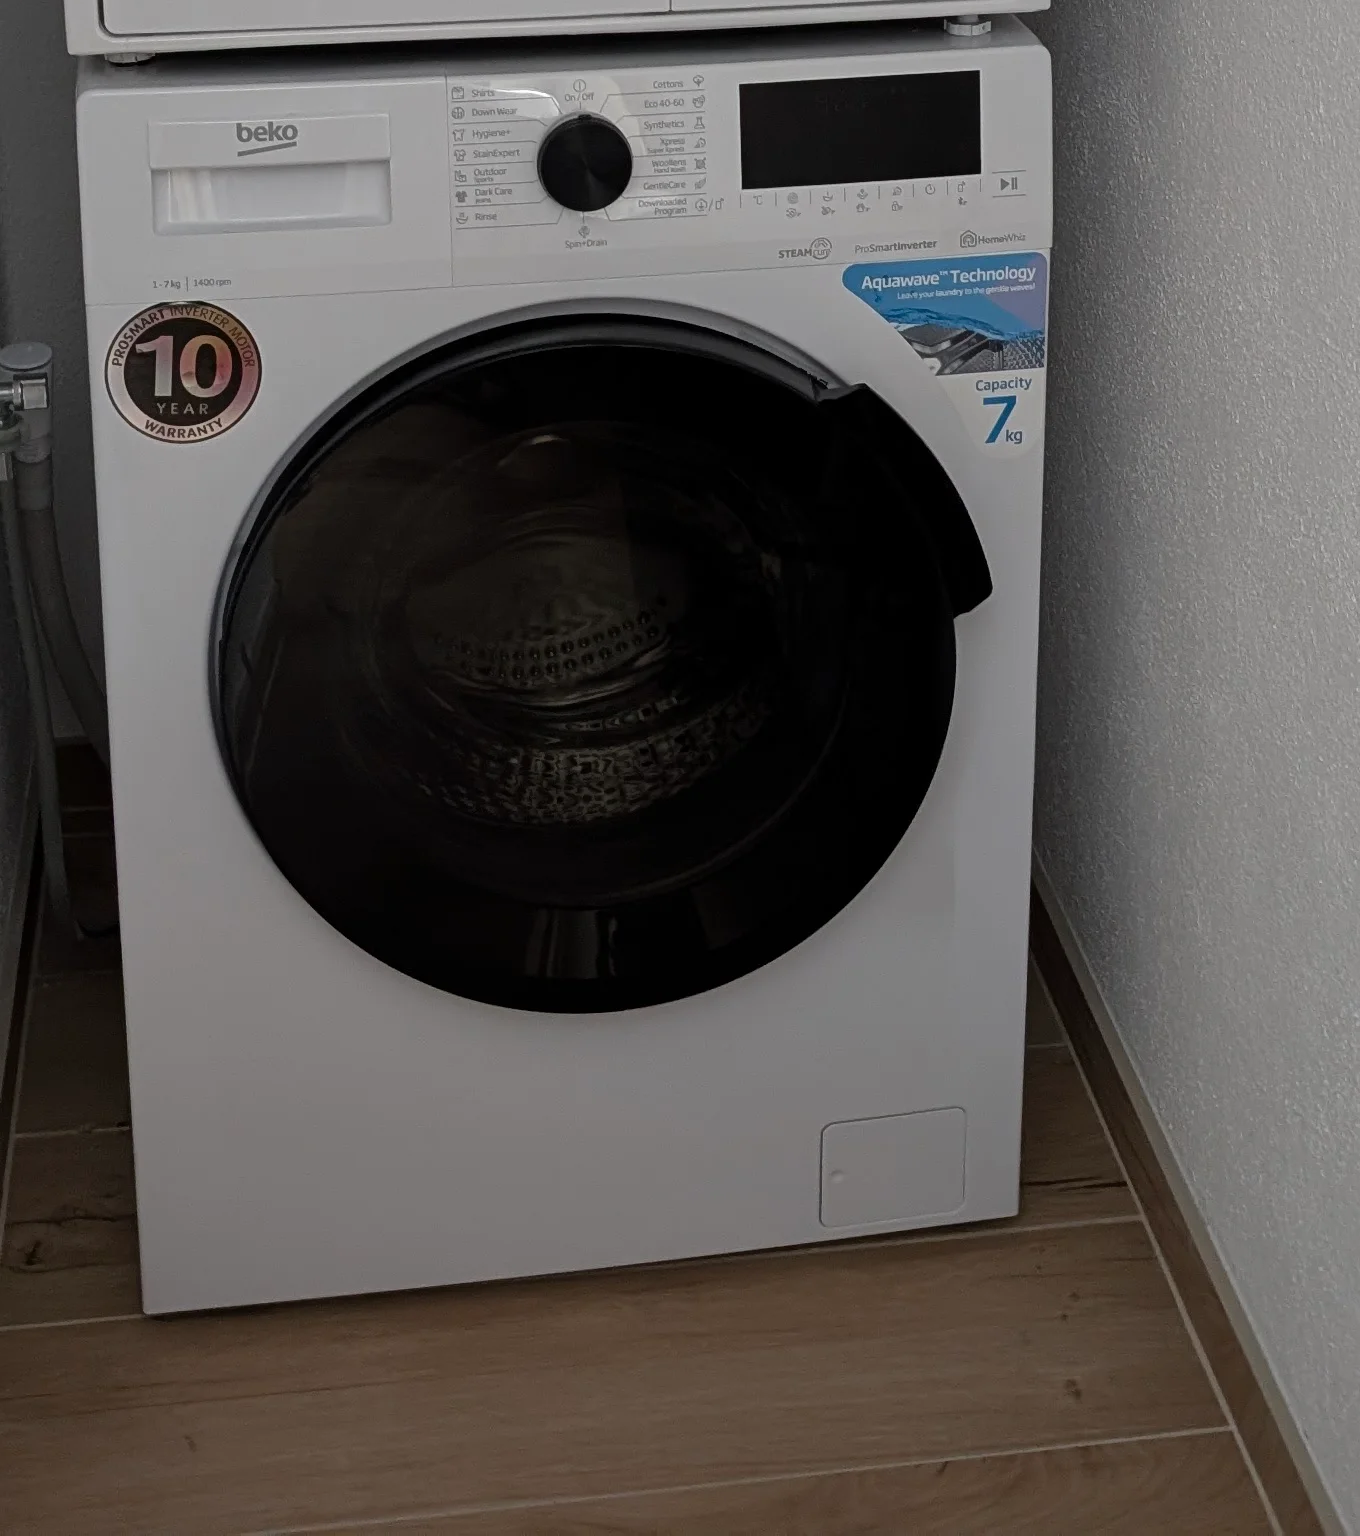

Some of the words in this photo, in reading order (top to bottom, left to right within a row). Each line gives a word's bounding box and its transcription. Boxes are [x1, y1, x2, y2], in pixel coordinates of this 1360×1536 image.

[653, 80, 684, 89] Cottons
[471, 89, 495, 98] Shirts
[644, 100, 658, 108] Eco
[659, 98, 684, 107] 40-60
[472, 109, 496, 117] Down
[497, 107, 518, 115] Wear
[644, 120, 684, 131] Synthetics
[235, 122, 298, 145] beko
[474, 167, 507, 176] Outdoor
[643, 181, 686, 190] GentleCare
[475, 188, 492, 196] Dark
[495, 187, 512, 195] Care
[638, 198, 687, 208] Downloaded
[475, 213, 497, 221] Rinse
[654, 207, 687, 216] Program
[565, 238, 607, 249] Spin+Drain
[854, 240, 938, 253] ProSmartInverter
[949, 265, 1036, 284] Technology
[216, 279, 232, 287] rpm
[919, 290, 934, 299] your
[936, 288, 964, 297] laundry
[973, 286, 984, 294] the
[111, 308, 166, 367] PROSMART
[170, 306, 229, 328] INVERTER
[229, 326, 256, 367] MOTOR
[135, 334, 233, 398] 10
[975, 377, 1032, 392] Capacity
[156, 403, 209, 415] YEAR
[982, 395, 1017, 444] 7
[145, 418, 223, 438] WARRANTY
[1005, 429, 1022, 444] kg
